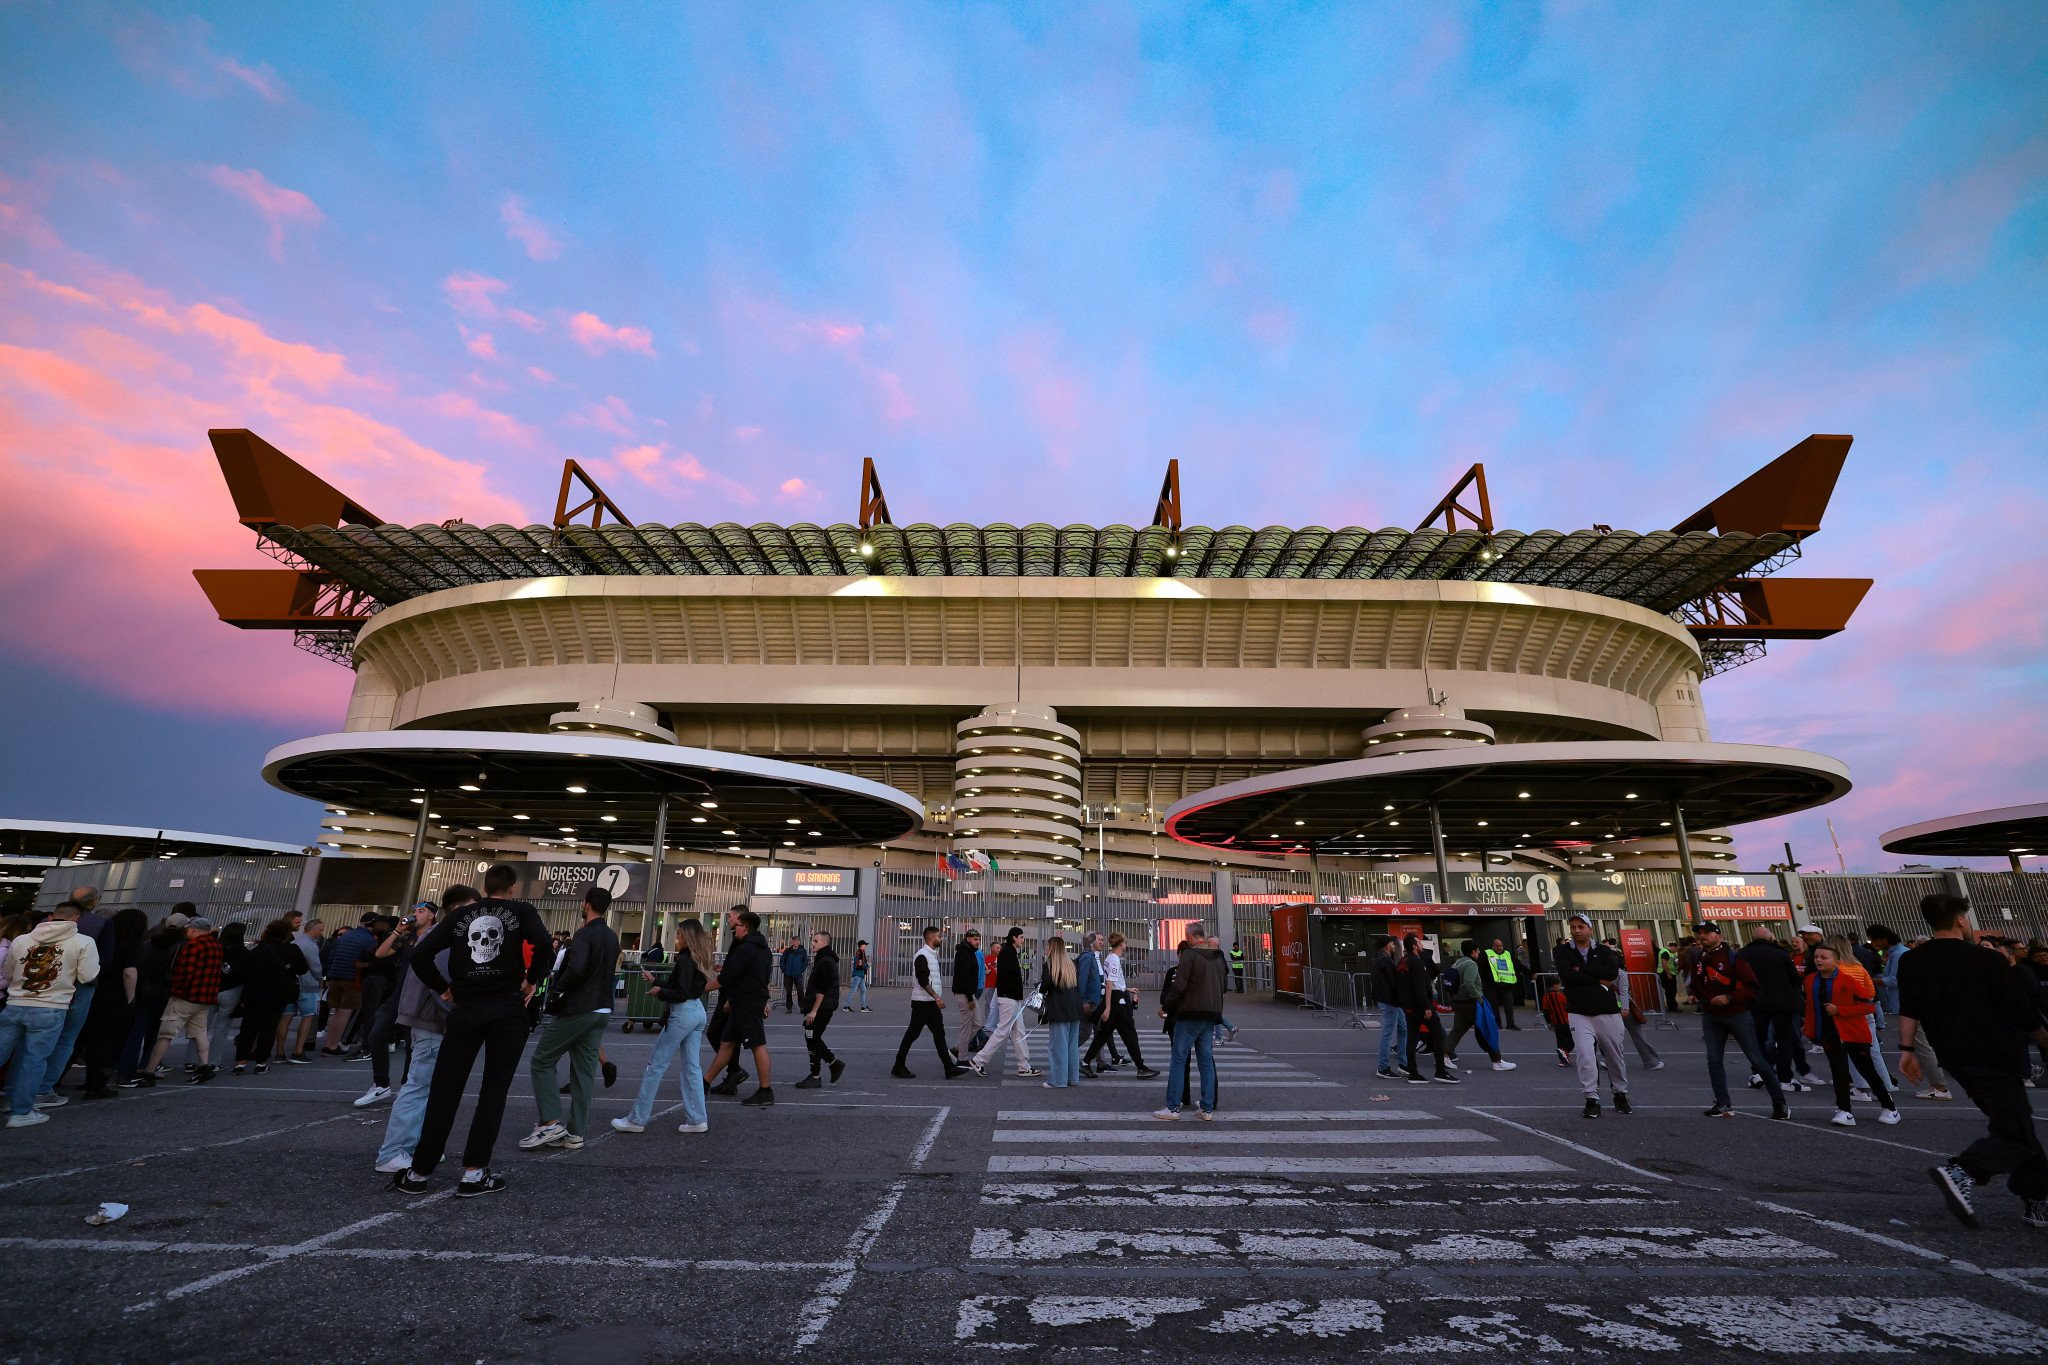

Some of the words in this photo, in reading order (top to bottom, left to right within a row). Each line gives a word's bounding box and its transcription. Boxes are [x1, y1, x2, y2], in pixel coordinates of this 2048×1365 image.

[538, 866, 596, 882] INGRESSO
[795, 872, 806, 883] NO
[807, 872, 841, 883] SMOKING
[551, 881, 579, 895] GATE
[608, 869, 620, 894] 7
[1465, 876, 1523, 892] INGRESSO
[1482, 891, 1509, 904] GATE
[1536, 878, 1550, 906] 8
[1700, 885, 1730, 897] MEDIA
[1731, 885, 1738, 897] E
[1740, 885, 1766, 897] STAFF
[1701, 906, 1744, 917] mirates
[1746, 906, 1758, 917] FLY
[1760, 906, 1787, 917] BETTER
